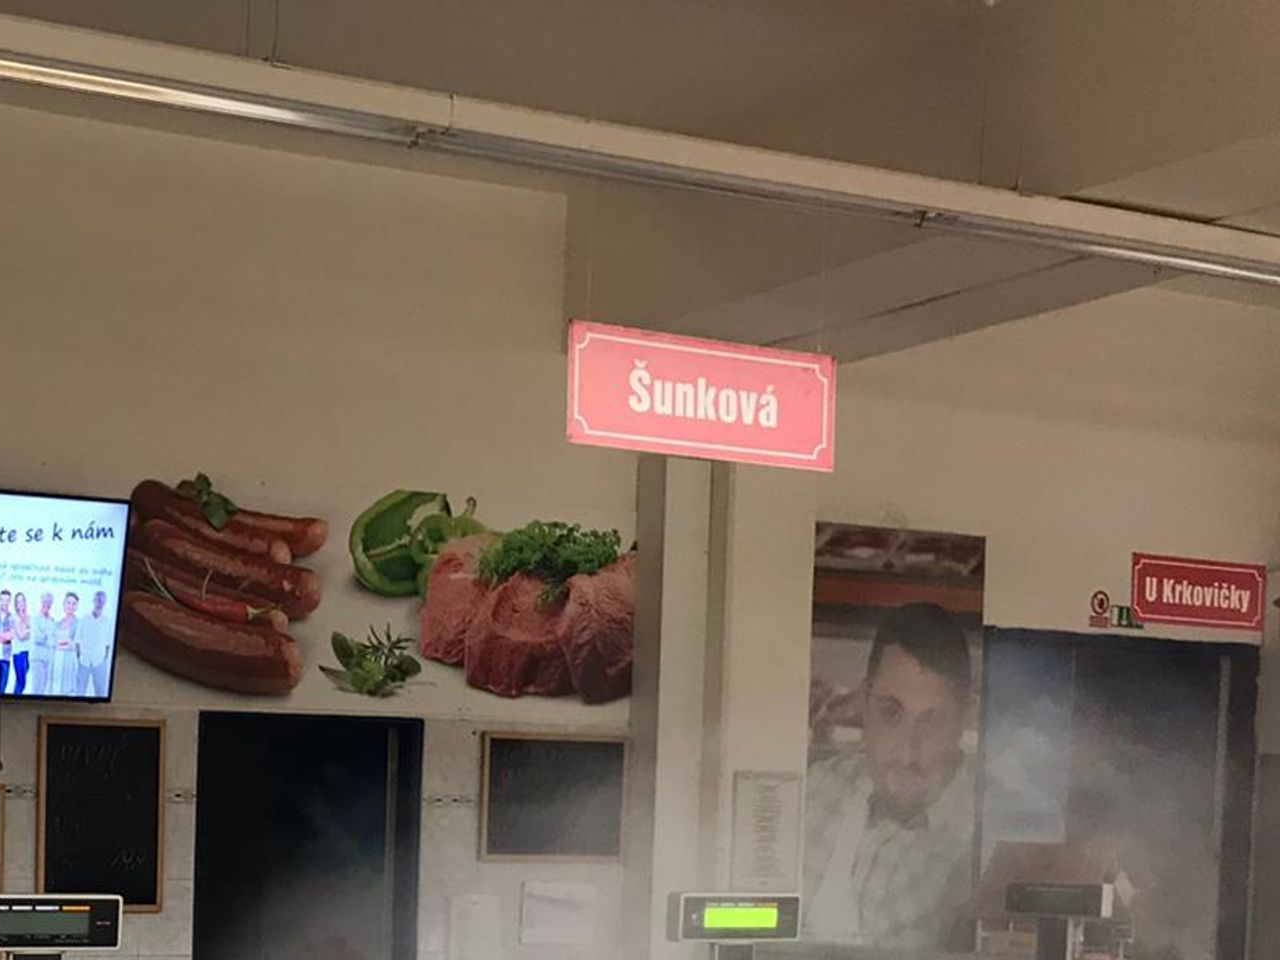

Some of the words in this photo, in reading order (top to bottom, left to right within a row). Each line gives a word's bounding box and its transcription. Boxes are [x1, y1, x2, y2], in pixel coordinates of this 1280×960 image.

[628, 358, 779, 429] Šunková
[25, 527, 44, 543] se
[51, 521, 64, 542] k
[70, 520, 116, 540] nám
[1144, 576, 1158, 602] U
[1162, 577, 1251, 614] Krkovičky
